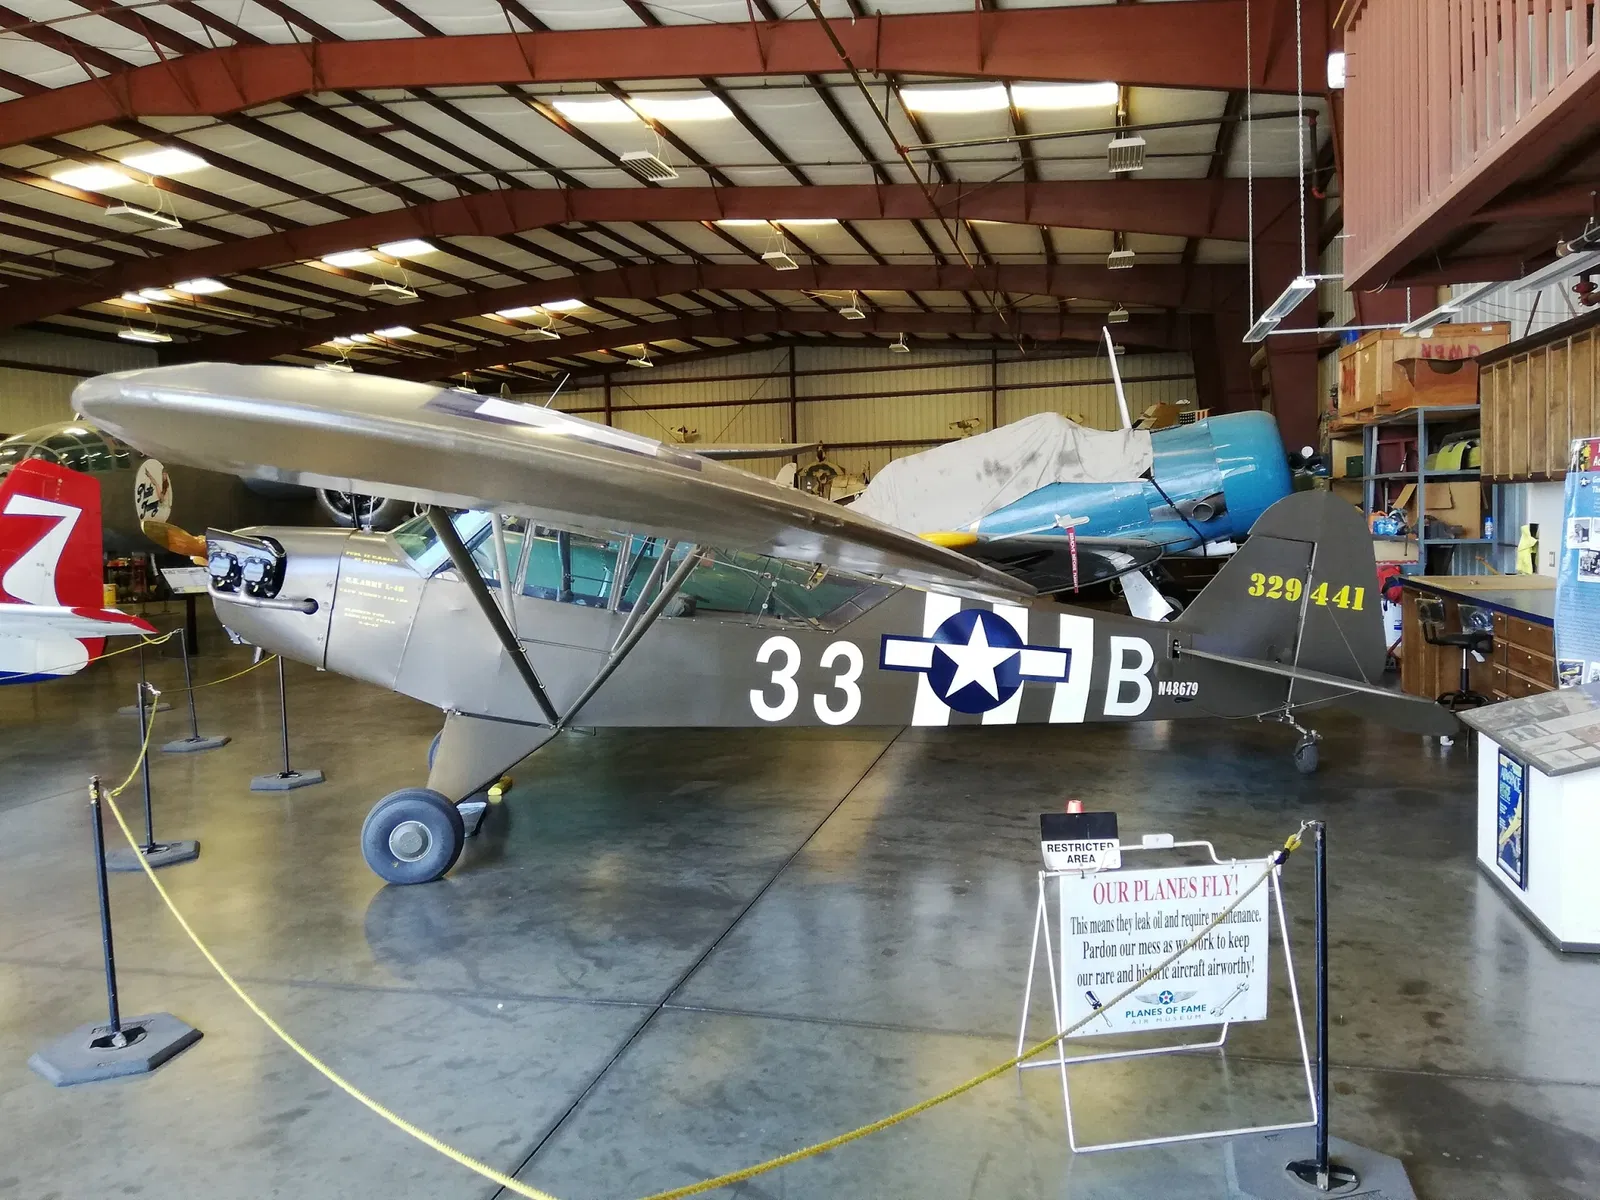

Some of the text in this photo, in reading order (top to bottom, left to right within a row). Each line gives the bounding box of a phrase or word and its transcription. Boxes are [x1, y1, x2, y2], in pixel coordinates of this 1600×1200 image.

[2, 493, 83, 607] 7
[1103, 635, 1155, 717] B
[1157, 681, 1199, 696] N48679
[1047, 842, 1114, 853] RESTRICTED
[1067, 854, 1096, 863] AREA
[1093, 873, 1239, 905] OUR PLANES FLY!
[1070, 915, 1088, 935] This
[1090, 917, 1115, 934] means
[1116, 913, 1133, 936] they
[1135, 911, 1151, 931] leak
[1152, 910, 1163, 929] oil
[1164, 909, 1179, 928] and
[1181, 907, 1209, 931] require
[1082, 940, 1117, 959] Pardon
[1119, 943, 1136, 957] our
[1138, 940, 1161, 955] mess
[1163, 940, 1173, 953] as
[1175, 938, 1189, 952] we
[1217, 933, 1226, 950] to
[1228, 930, 1250, 953] keep
[1077, 972, 1094, 987] our
[1095, 971, 1115, 985] rare
[1116, 964, 1133, 983] and
[1171, 958, 1205, 979] aircraft
[1207, 955, 1255, 978] airworthy!
[1125, 1004, 1207, 1018] PLANES OF FAME
[1131, 1013, 1202, 1025] AIR MUSEUM
